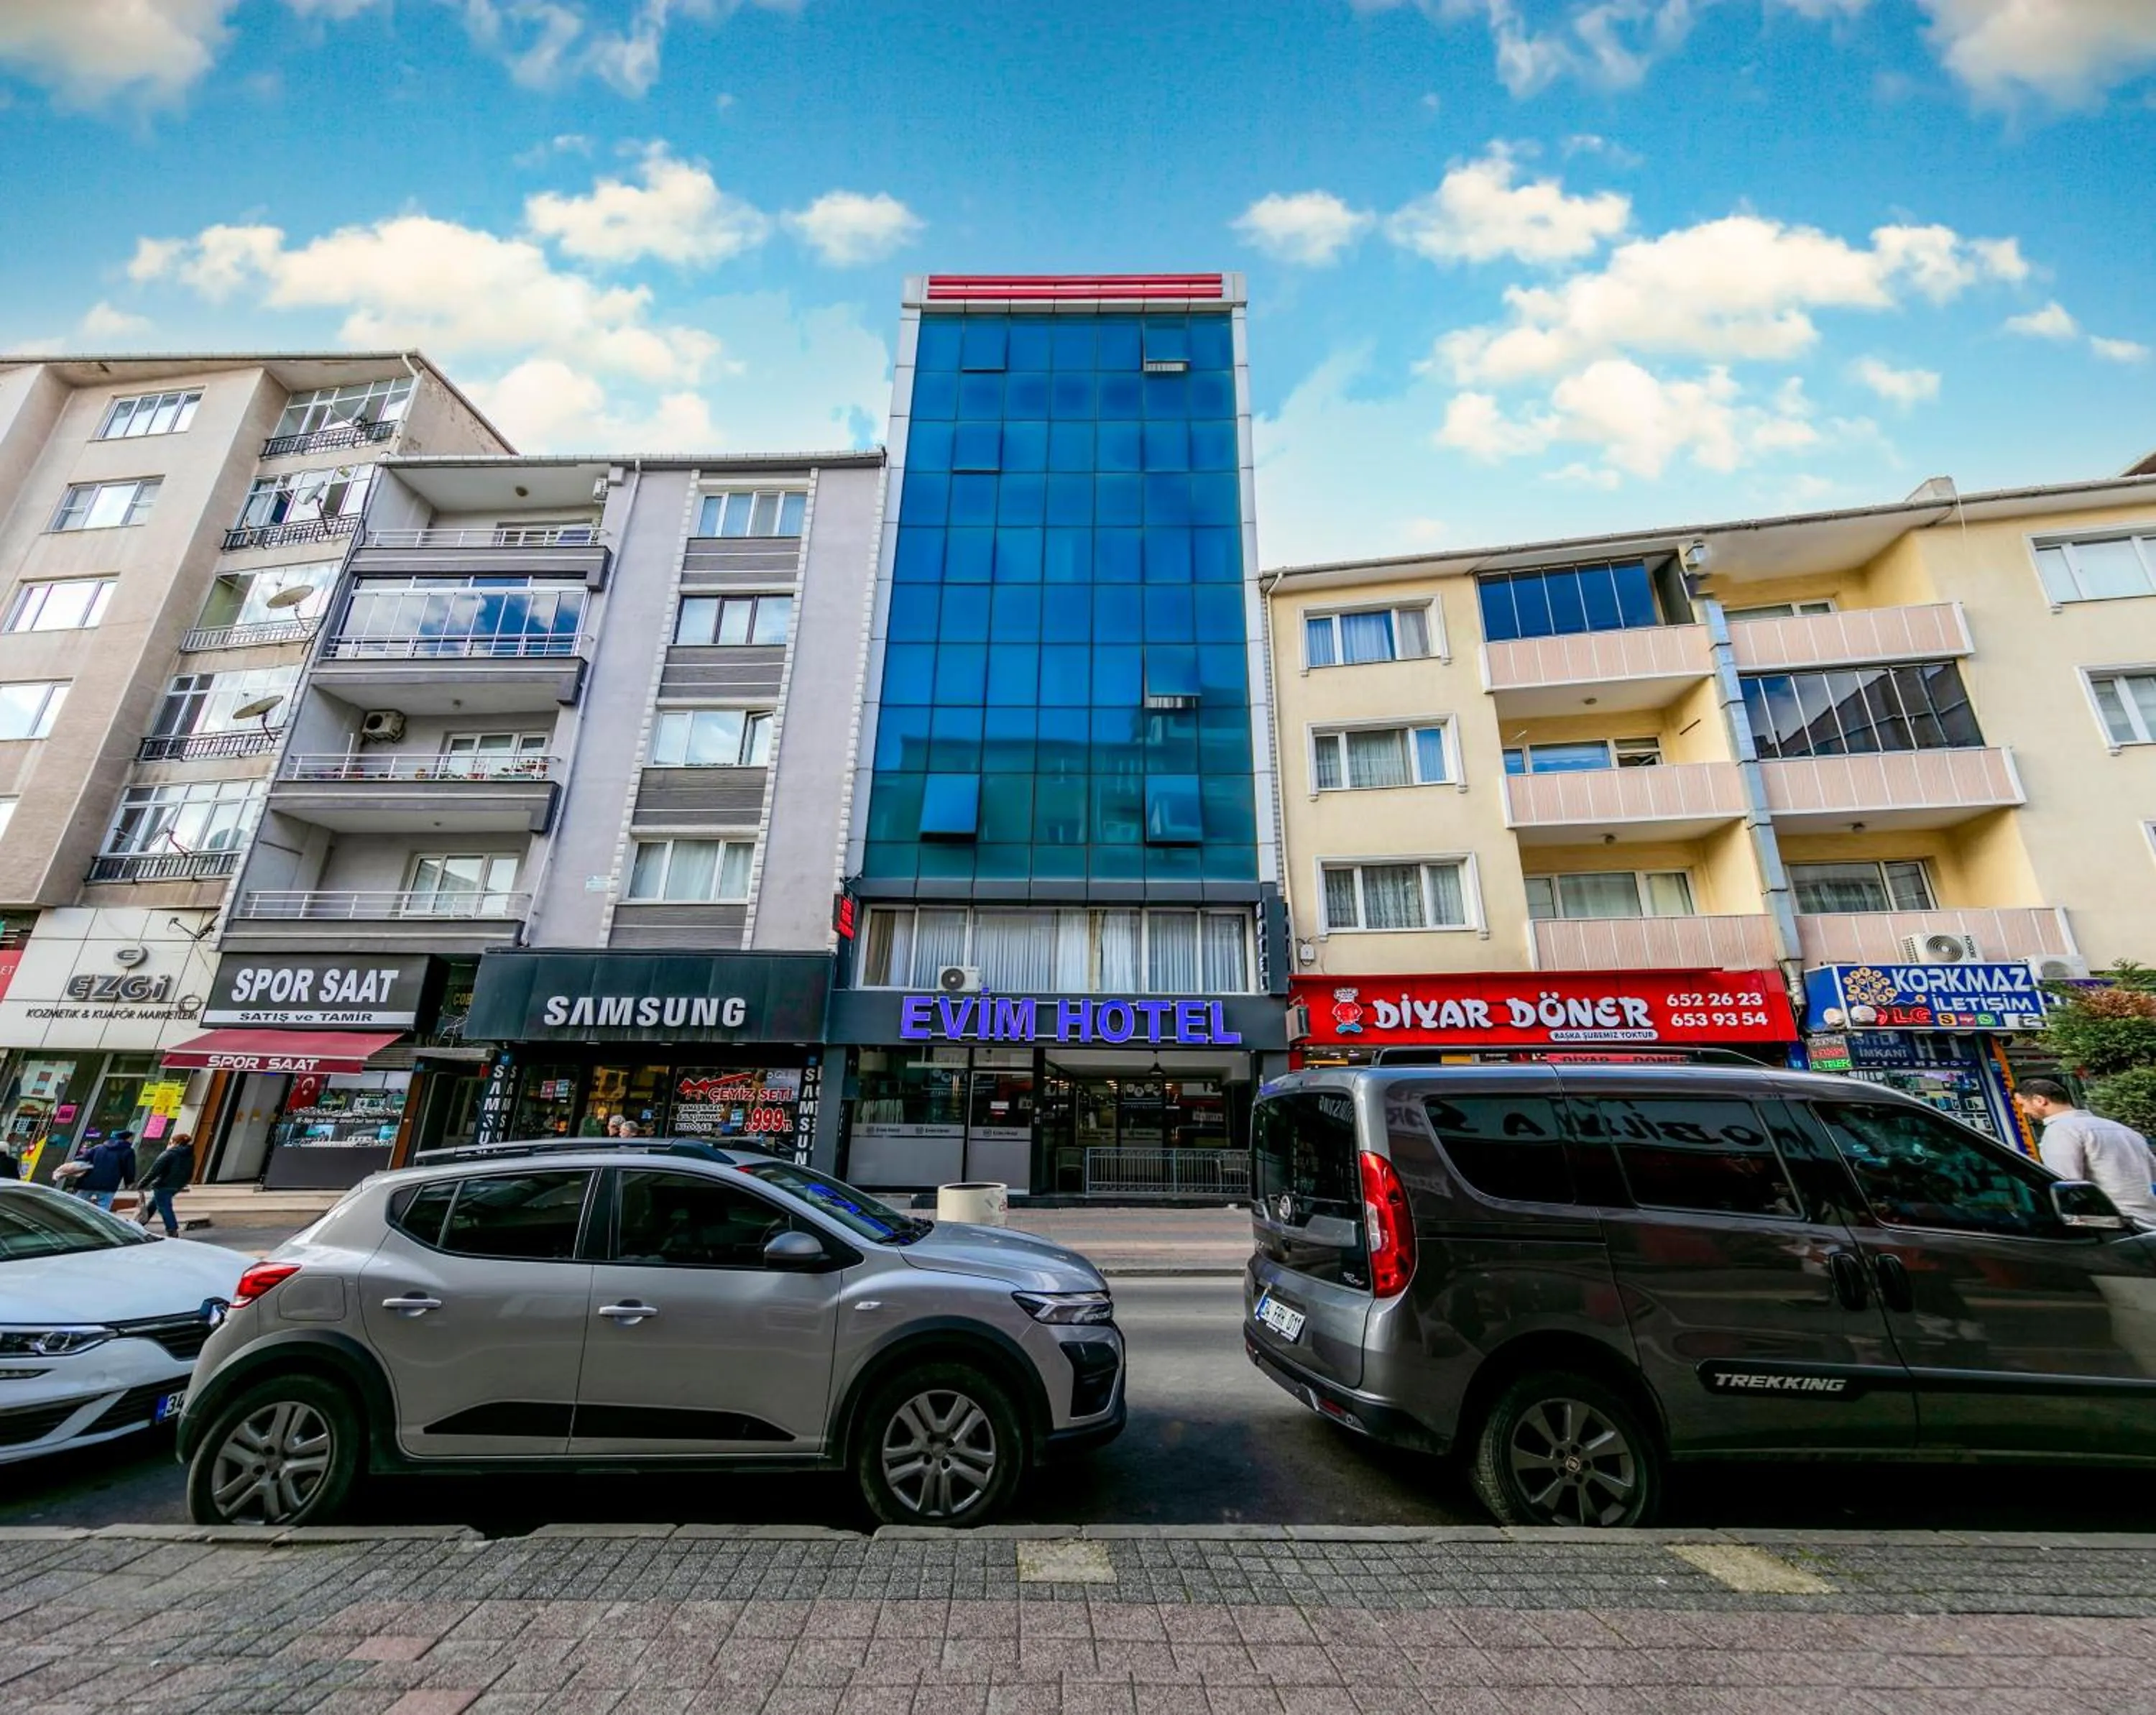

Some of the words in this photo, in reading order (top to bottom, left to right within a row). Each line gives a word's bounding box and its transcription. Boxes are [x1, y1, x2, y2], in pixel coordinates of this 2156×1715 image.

[0, 965, 14, 975] ET
[231, 968, 313, 1003] SPOR
[319, 969, 399, 1003] SAAT
[1892, 967, 2032, 993] KORKMAZ
[1667, 993, 1703, 1008] 652
[1708, 993, 1733, 1007] 26
[1737, 992, 1763, 1006] 23
[1931, 993, 2034, 1013] İLETİŞİM
[81, 1009, 90, 1019] &
[239, 1012, 288, 1023] SATIŞ
[320, 1011, 373, 1021] TAMİR
[544, 996, 745, 1026] SAMSUNG
[899, 987, 1037, 1042] EVİM
[1056, 998, 1242, 1044] HOTEL
[1373, 993, 1493, 1030] DİYAR
[1506, 991, 1654, 1029] DÖNER
[1671, 1013, 1708, 1027] 653
[1712, 1012, 1738, 1026] 93
[1741, 1011, 1768, 1025] 54
[207, 1055, 259, 1068] SPOR
[268, 1058, 319, 1071] SAAT
[709, 1085, 755, 1104] ÇEYİZ
[759, 1086, 794, 1102] SETİ
[477, 1065, 505, 1152] SAMSU
[1715, 1373, 1846, 1392] TREKKING
[166, 1393, 184, 1414] 34
